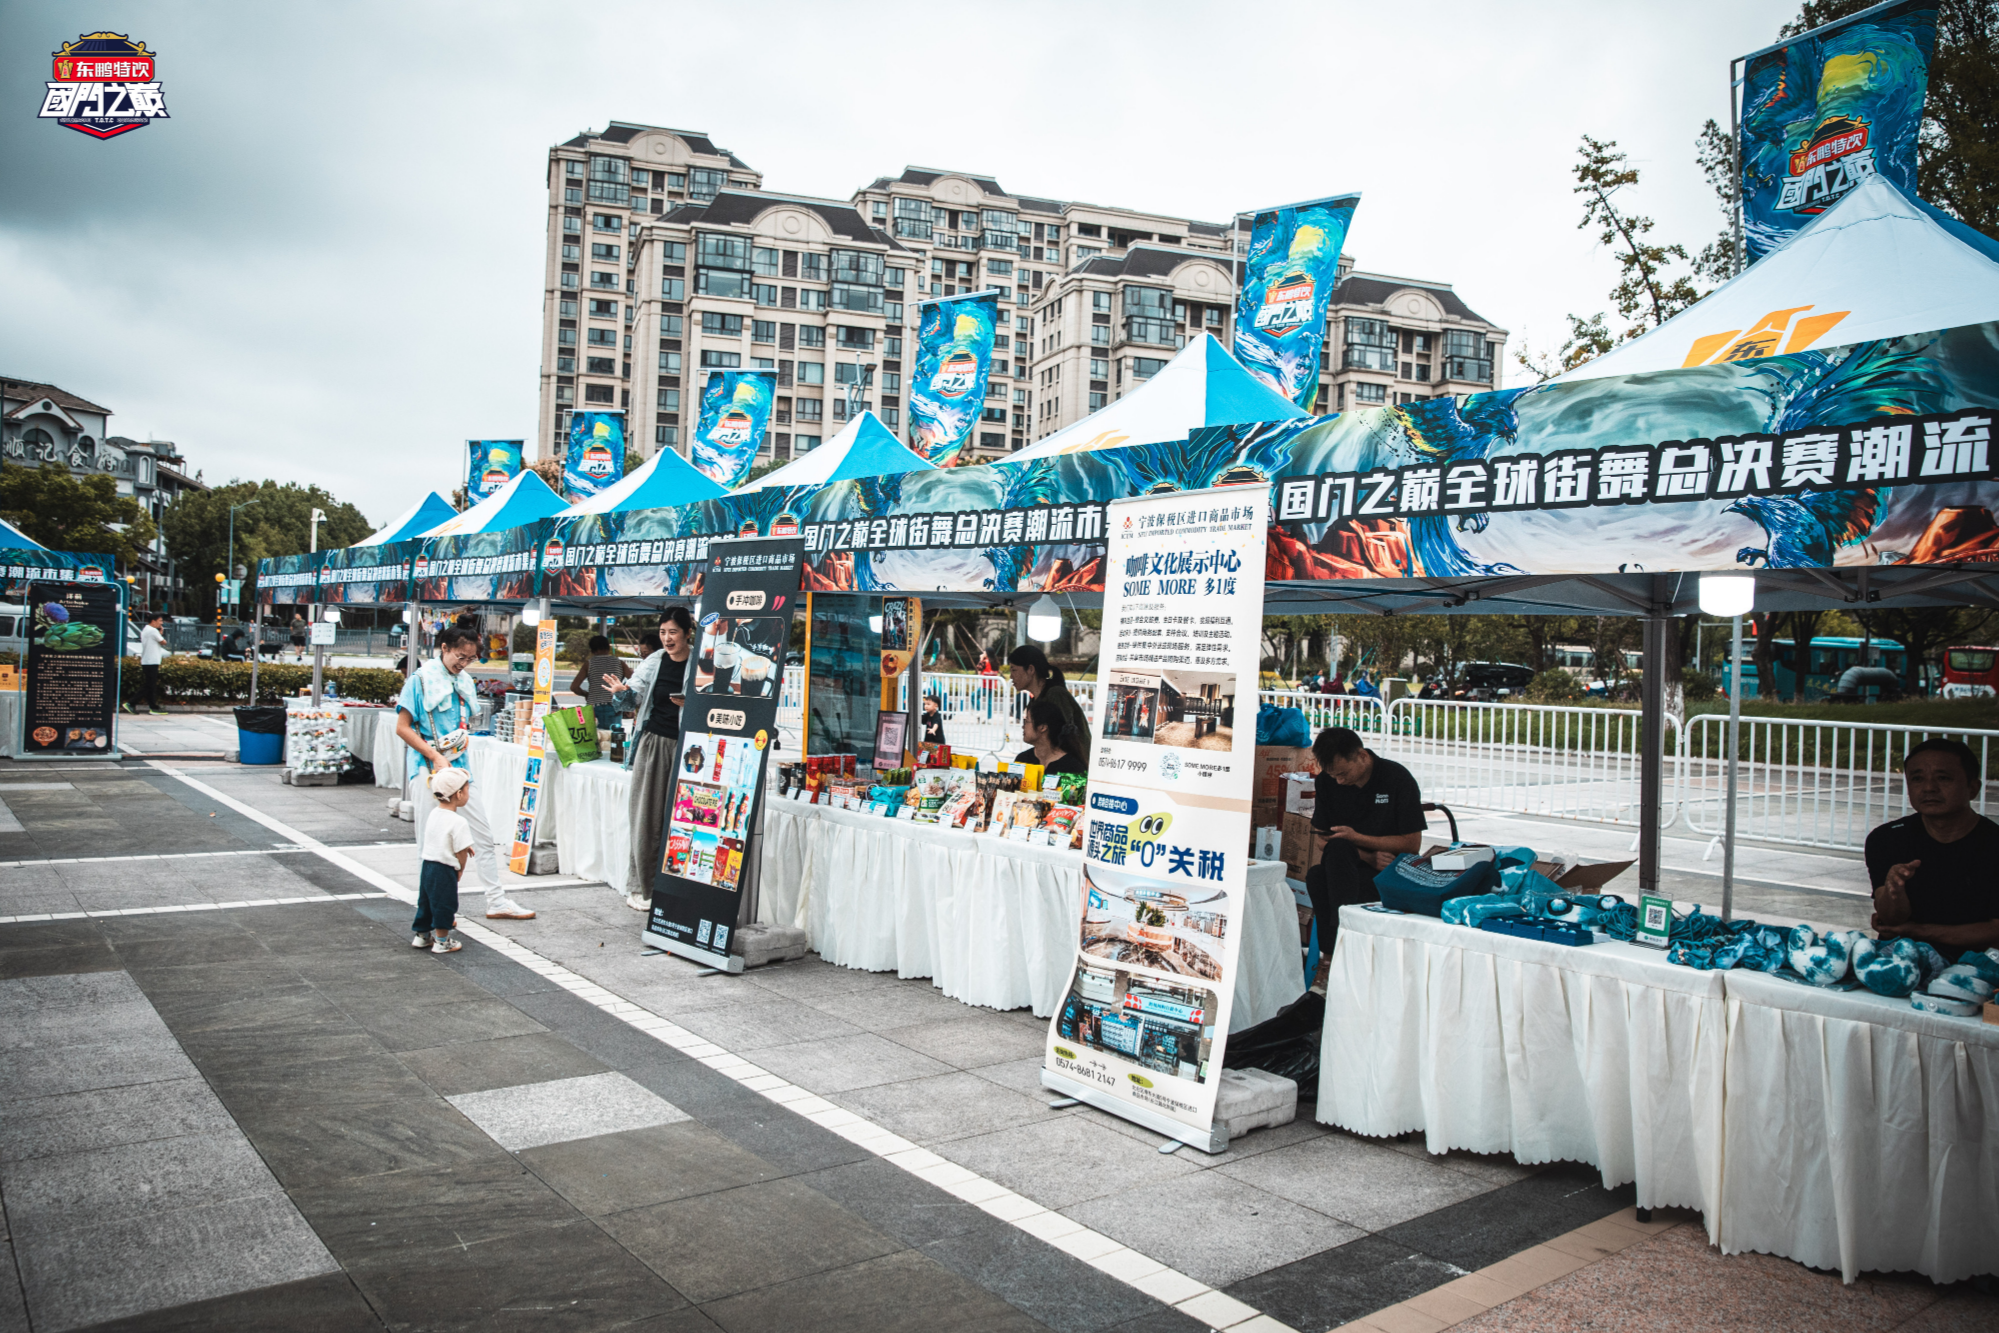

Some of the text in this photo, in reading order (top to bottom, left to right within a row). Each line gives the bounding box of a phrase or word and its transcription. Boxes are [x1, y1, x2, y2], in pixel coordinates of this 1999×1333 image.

[1806, 132, 1863, 167] 东鹏特饮
[1280, 415, 1992, 521] 国门之巅全球街舞总决赛潮流
[803, 504, 1110, 551] 国门之巅全球街舞总决赛潮流市
[1138, 506, 1254, 529] 宁波保税区进口商品市场
[1227, 523, 1253, 531] MARKET
[565, 533, 735, 567] 国门之巅全球街舞总决赛潮流
[1125, 549, 1242, 578] 咖啡文化展示中心
[735, 594, 763, 606] 手冲咖啡
[1123, 576, 1237, 597] SOME MORE 多1度
[1127, 760, 1148, 772] 9999
[1089, 819, 1129, 846] 世界商品
[1056, 1057, 1116, 1086] 0574-8681 2147
